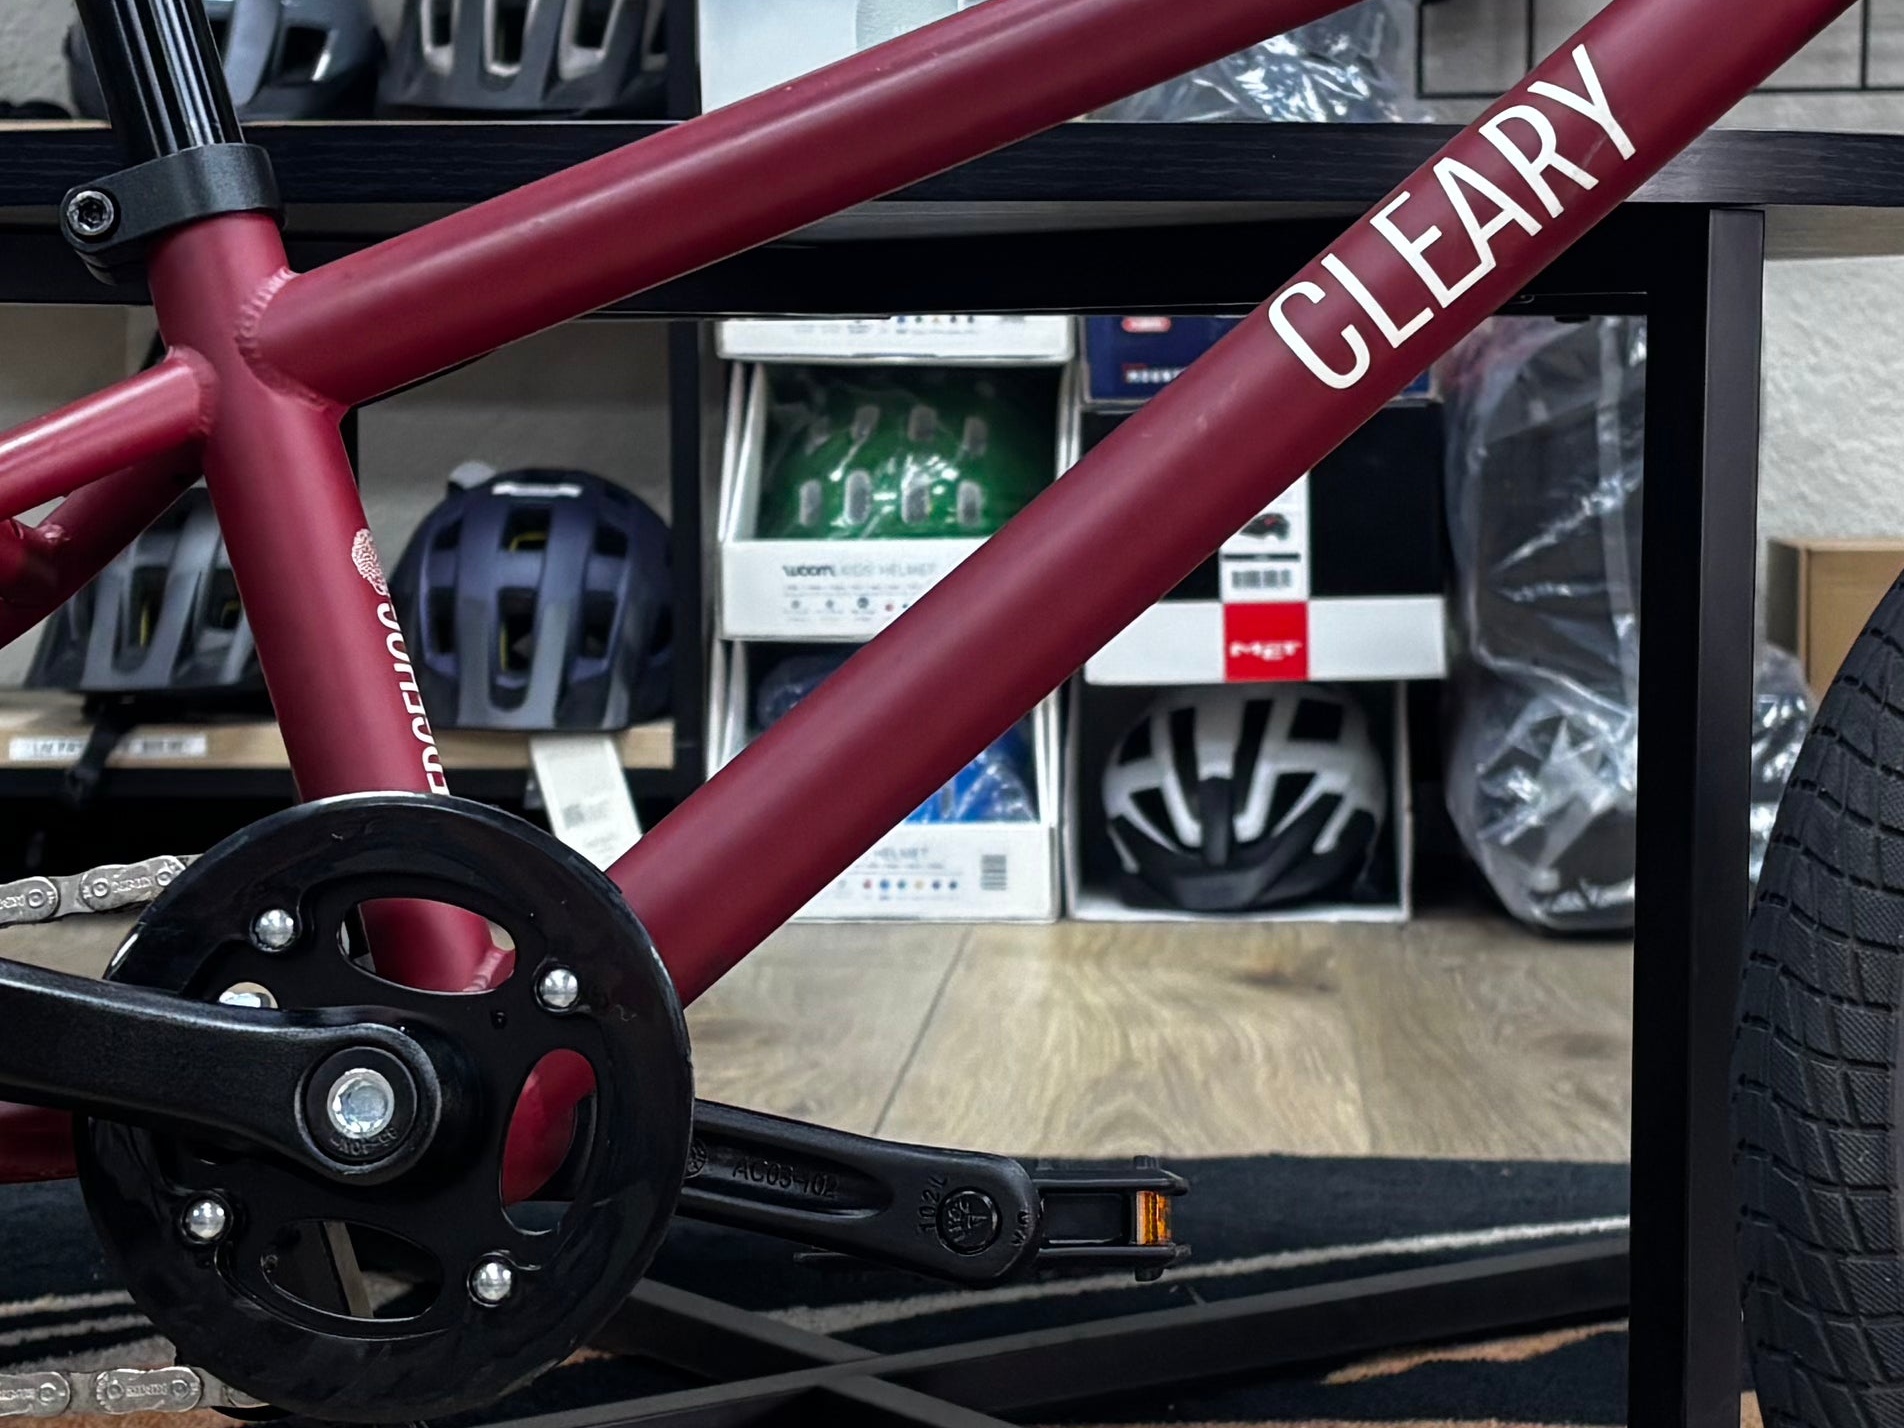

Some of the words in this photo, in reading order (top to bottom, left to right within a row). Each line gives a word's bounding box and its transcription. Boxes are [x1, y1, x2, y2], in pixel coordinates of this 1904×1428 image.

[1268, 43, 1636, 389] CLEARY
[782, 563, 836, 578] woom
[1229, 640, 1303, 661] MET
